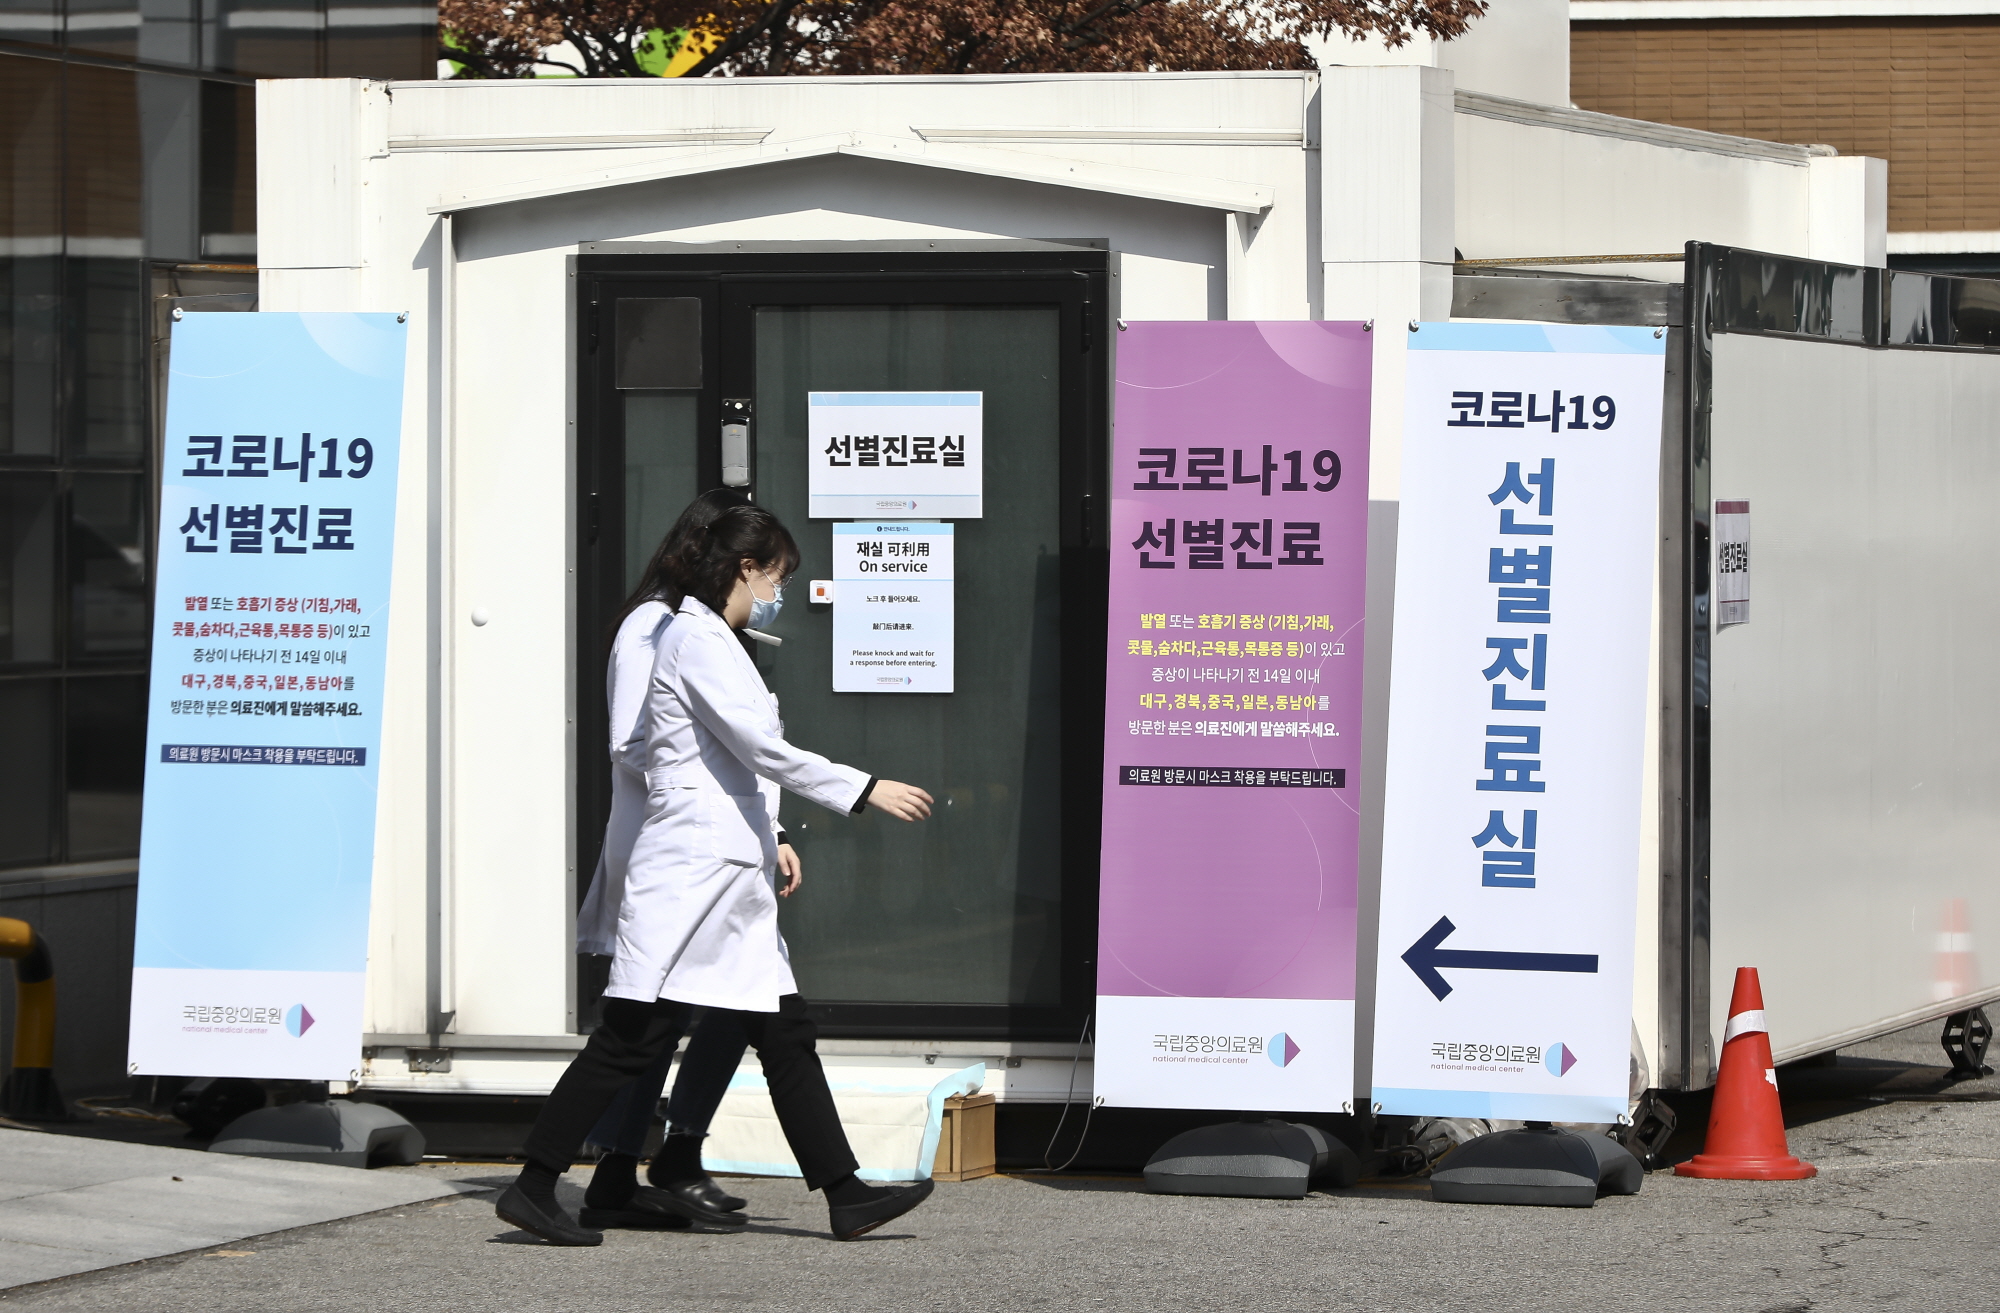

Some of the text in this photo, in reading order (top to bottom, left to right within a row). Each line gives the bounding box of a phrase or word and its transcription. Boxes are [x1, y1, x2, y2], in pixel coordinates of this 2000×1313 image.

[1447, 390, 1617, 433] 코로나19
[182, 433, 373, 482] 코로나19
[825, 435, 965, 467] 선별진료실
[1134, 444, 1341, 496] 코로나19
[179, 504, 354, 554] 선별진료
[857, 541, 929, 557] 재실 可利用
[1132, 518, 1324, 569] 선별진료
[859, 560, 928, 572] On service
[1719, 542, 1747, 573] 선별진료실
[185, 596, 361, 614] 발열 또는 호흡기 증상 (기침,가래,
[173, 622, 370, 640] 콧물,숨차다,근육통,목통증 등)이 있고
[1140, 613, 1334, 632] 발열 또는 호흡기 증상 (기침,가래,
[193, 648, 347, 664] 증상이 나타나기 전 14일 이내
[1128, 640, 1345, 658] 콧물,숨차다,근육통,목통증 등)이 있고
[1152, 667, 1320, 684] 증상이 나타나기 전 14일 이내
[1471, 458, 1556, 889] 선별진료실
[171, 700, 362, 717] 방문한 분은 의료진에게 말씀해주세요.
[1128, 720, 1340, 737] 방문한 분은 의료진에게 말씀해주세요.
[169, 747, 359, 764] 의료원 방문시 마스크 착용을 부탁드립니다.
[1129, 769, 1337, 786] 의료원 방문시 마스크 착용을 부탁드립니다.
[183, 1006, 282, 1024] 국립중앙의료원
[1153, 1034, 1263, 1054] 국립중앙의료원
[1431, 1042, 1540, 1063] 국립중앙의료원
[1465, 1064, 1496, 1072] medical
